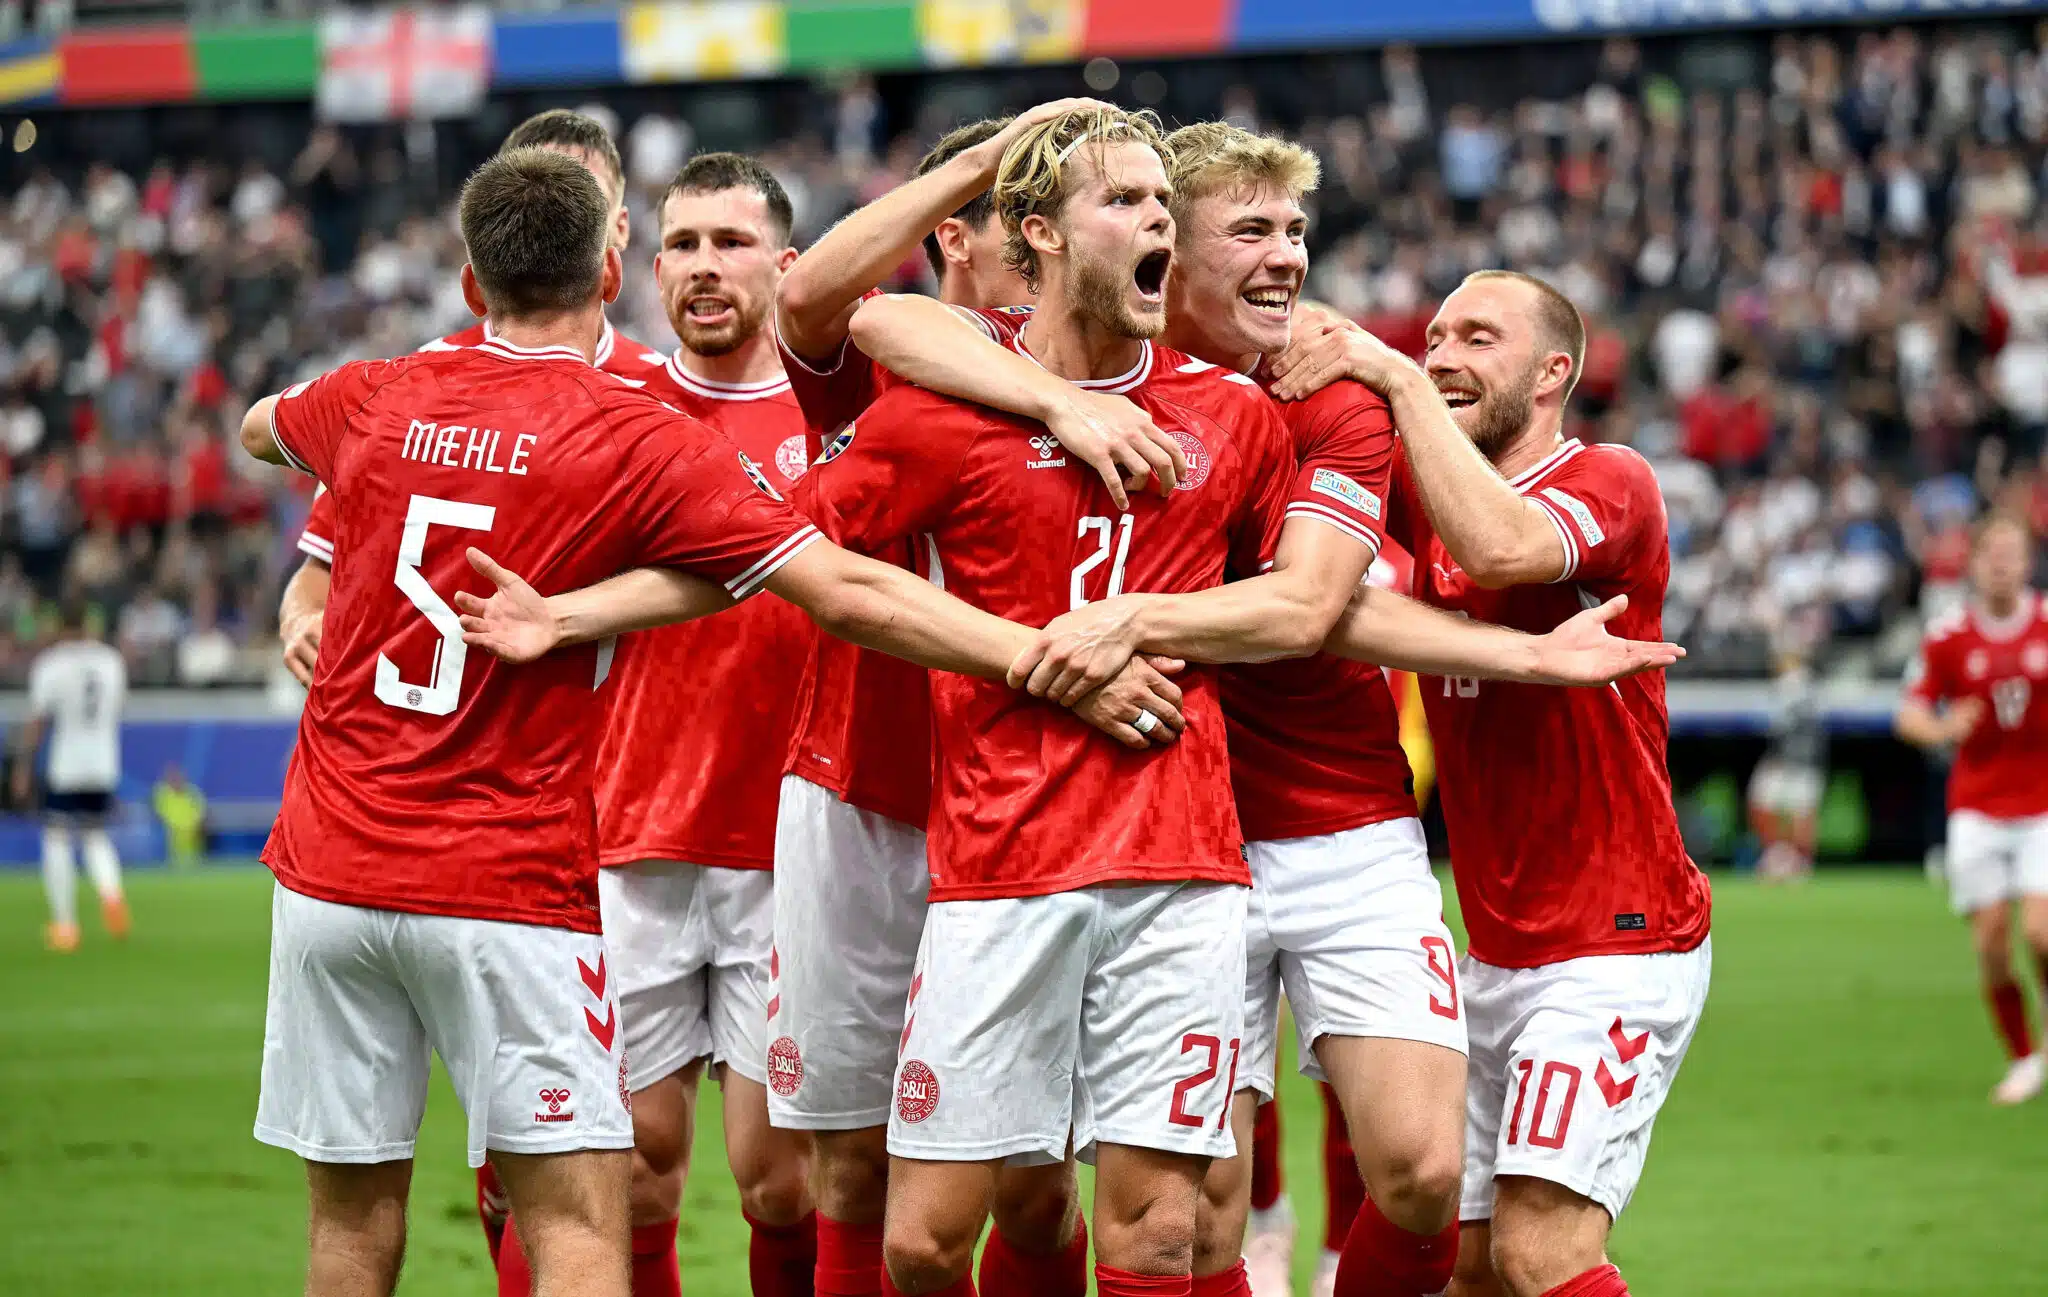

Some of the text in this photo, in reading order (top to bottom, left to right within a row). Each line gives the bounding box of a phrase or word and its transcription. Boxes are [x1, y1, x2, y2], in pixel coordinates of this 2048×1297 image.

[401, 419, 537, 476] MÆHLE
[1026, 457, 1066, 470] hummel
[1314, 475, 1379, 513] FOUNDATION
[1070, 514, 1135, 611] 21
[374, 494, 496, 716] 5
[1420, 936, 1459, 1021] 9
[774, 1055, 796, 1075] DBU
[1168, 1033, 1241, 1130] 21
[901, 1080, 927, 1100] DBU
[923, 1081, 938, 1114] UNION
[1507, 1059, 1582, 1150] 10
[535, 1112, 573, 1122] hummel
[902, 1111, 922, 1121] 1889
